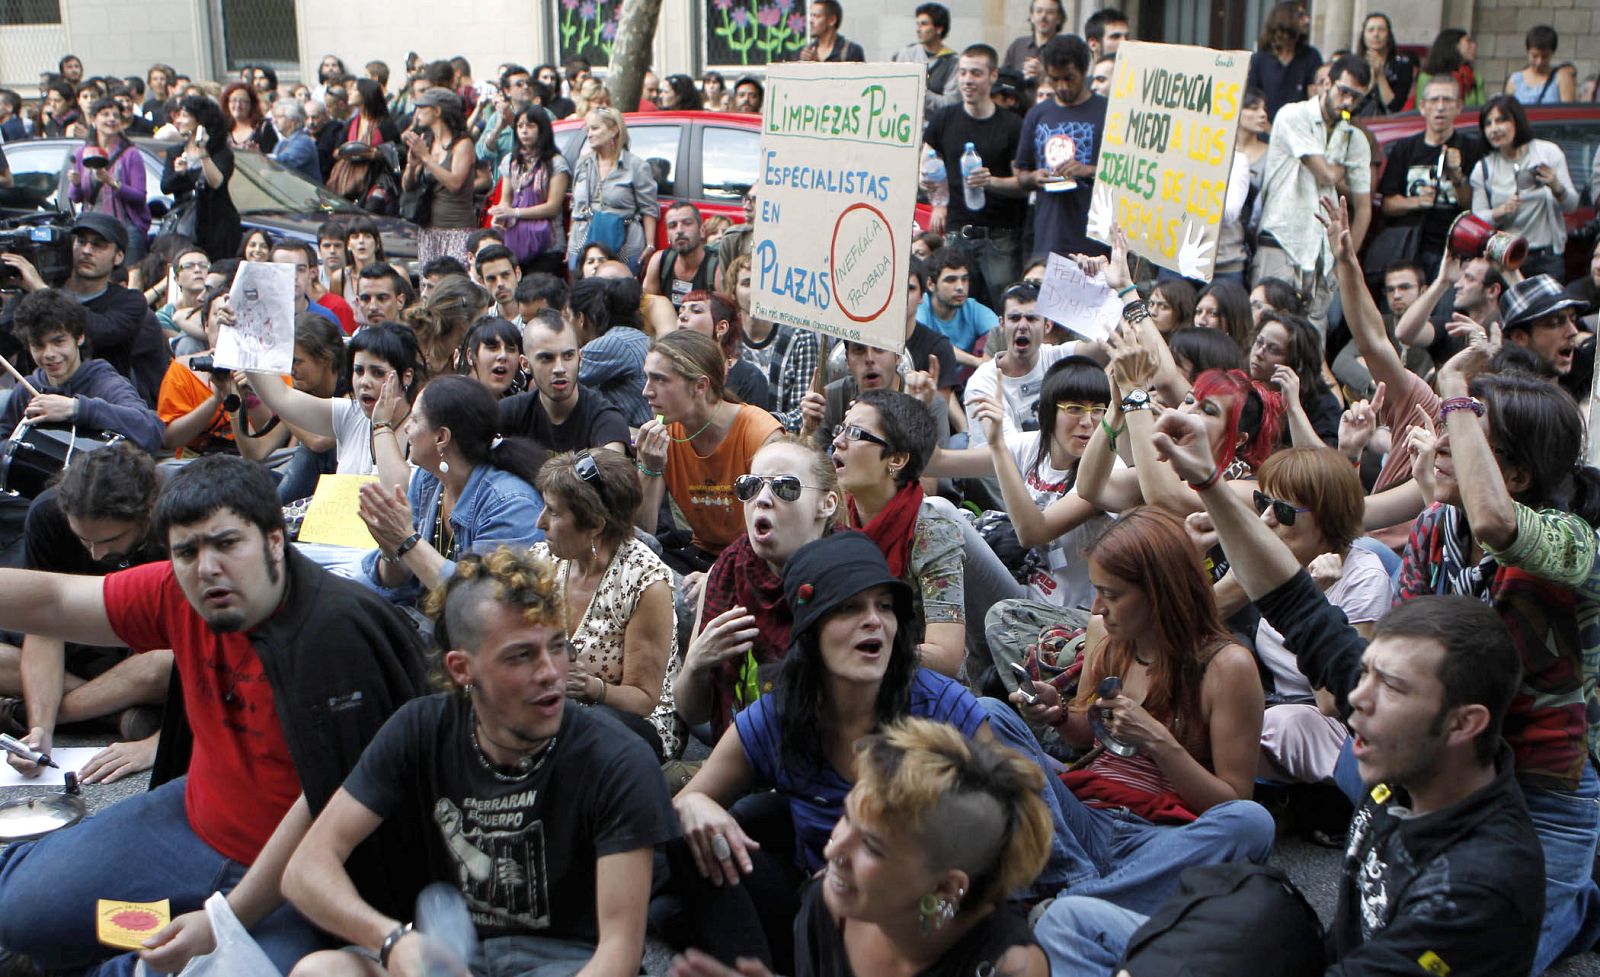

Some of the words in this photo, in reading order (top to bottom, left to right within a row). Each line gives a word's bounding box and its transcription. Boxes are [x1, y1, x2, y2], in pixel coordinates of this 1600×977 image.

[1142, 67, 1213, 117] VIOLENCIA
[1212, 81, 1239, 121] ES
[1107, 112, 1123, 145] EL
[1125, 108, 1171, 153] MIEDO
[1169, 119, 1182, 151] A
[1187, 121, 1226, 166] LOS
[762, 200, 780, 224] EN
[1099, 152, 1158, 200] IDEALES
[1162, 169, 1185, 203] DE
[1186, 175, 1226, 224] LOS
[834, 219, 882, 285] INEFICACIA
[847, 255, 891, 311] PROBADA
